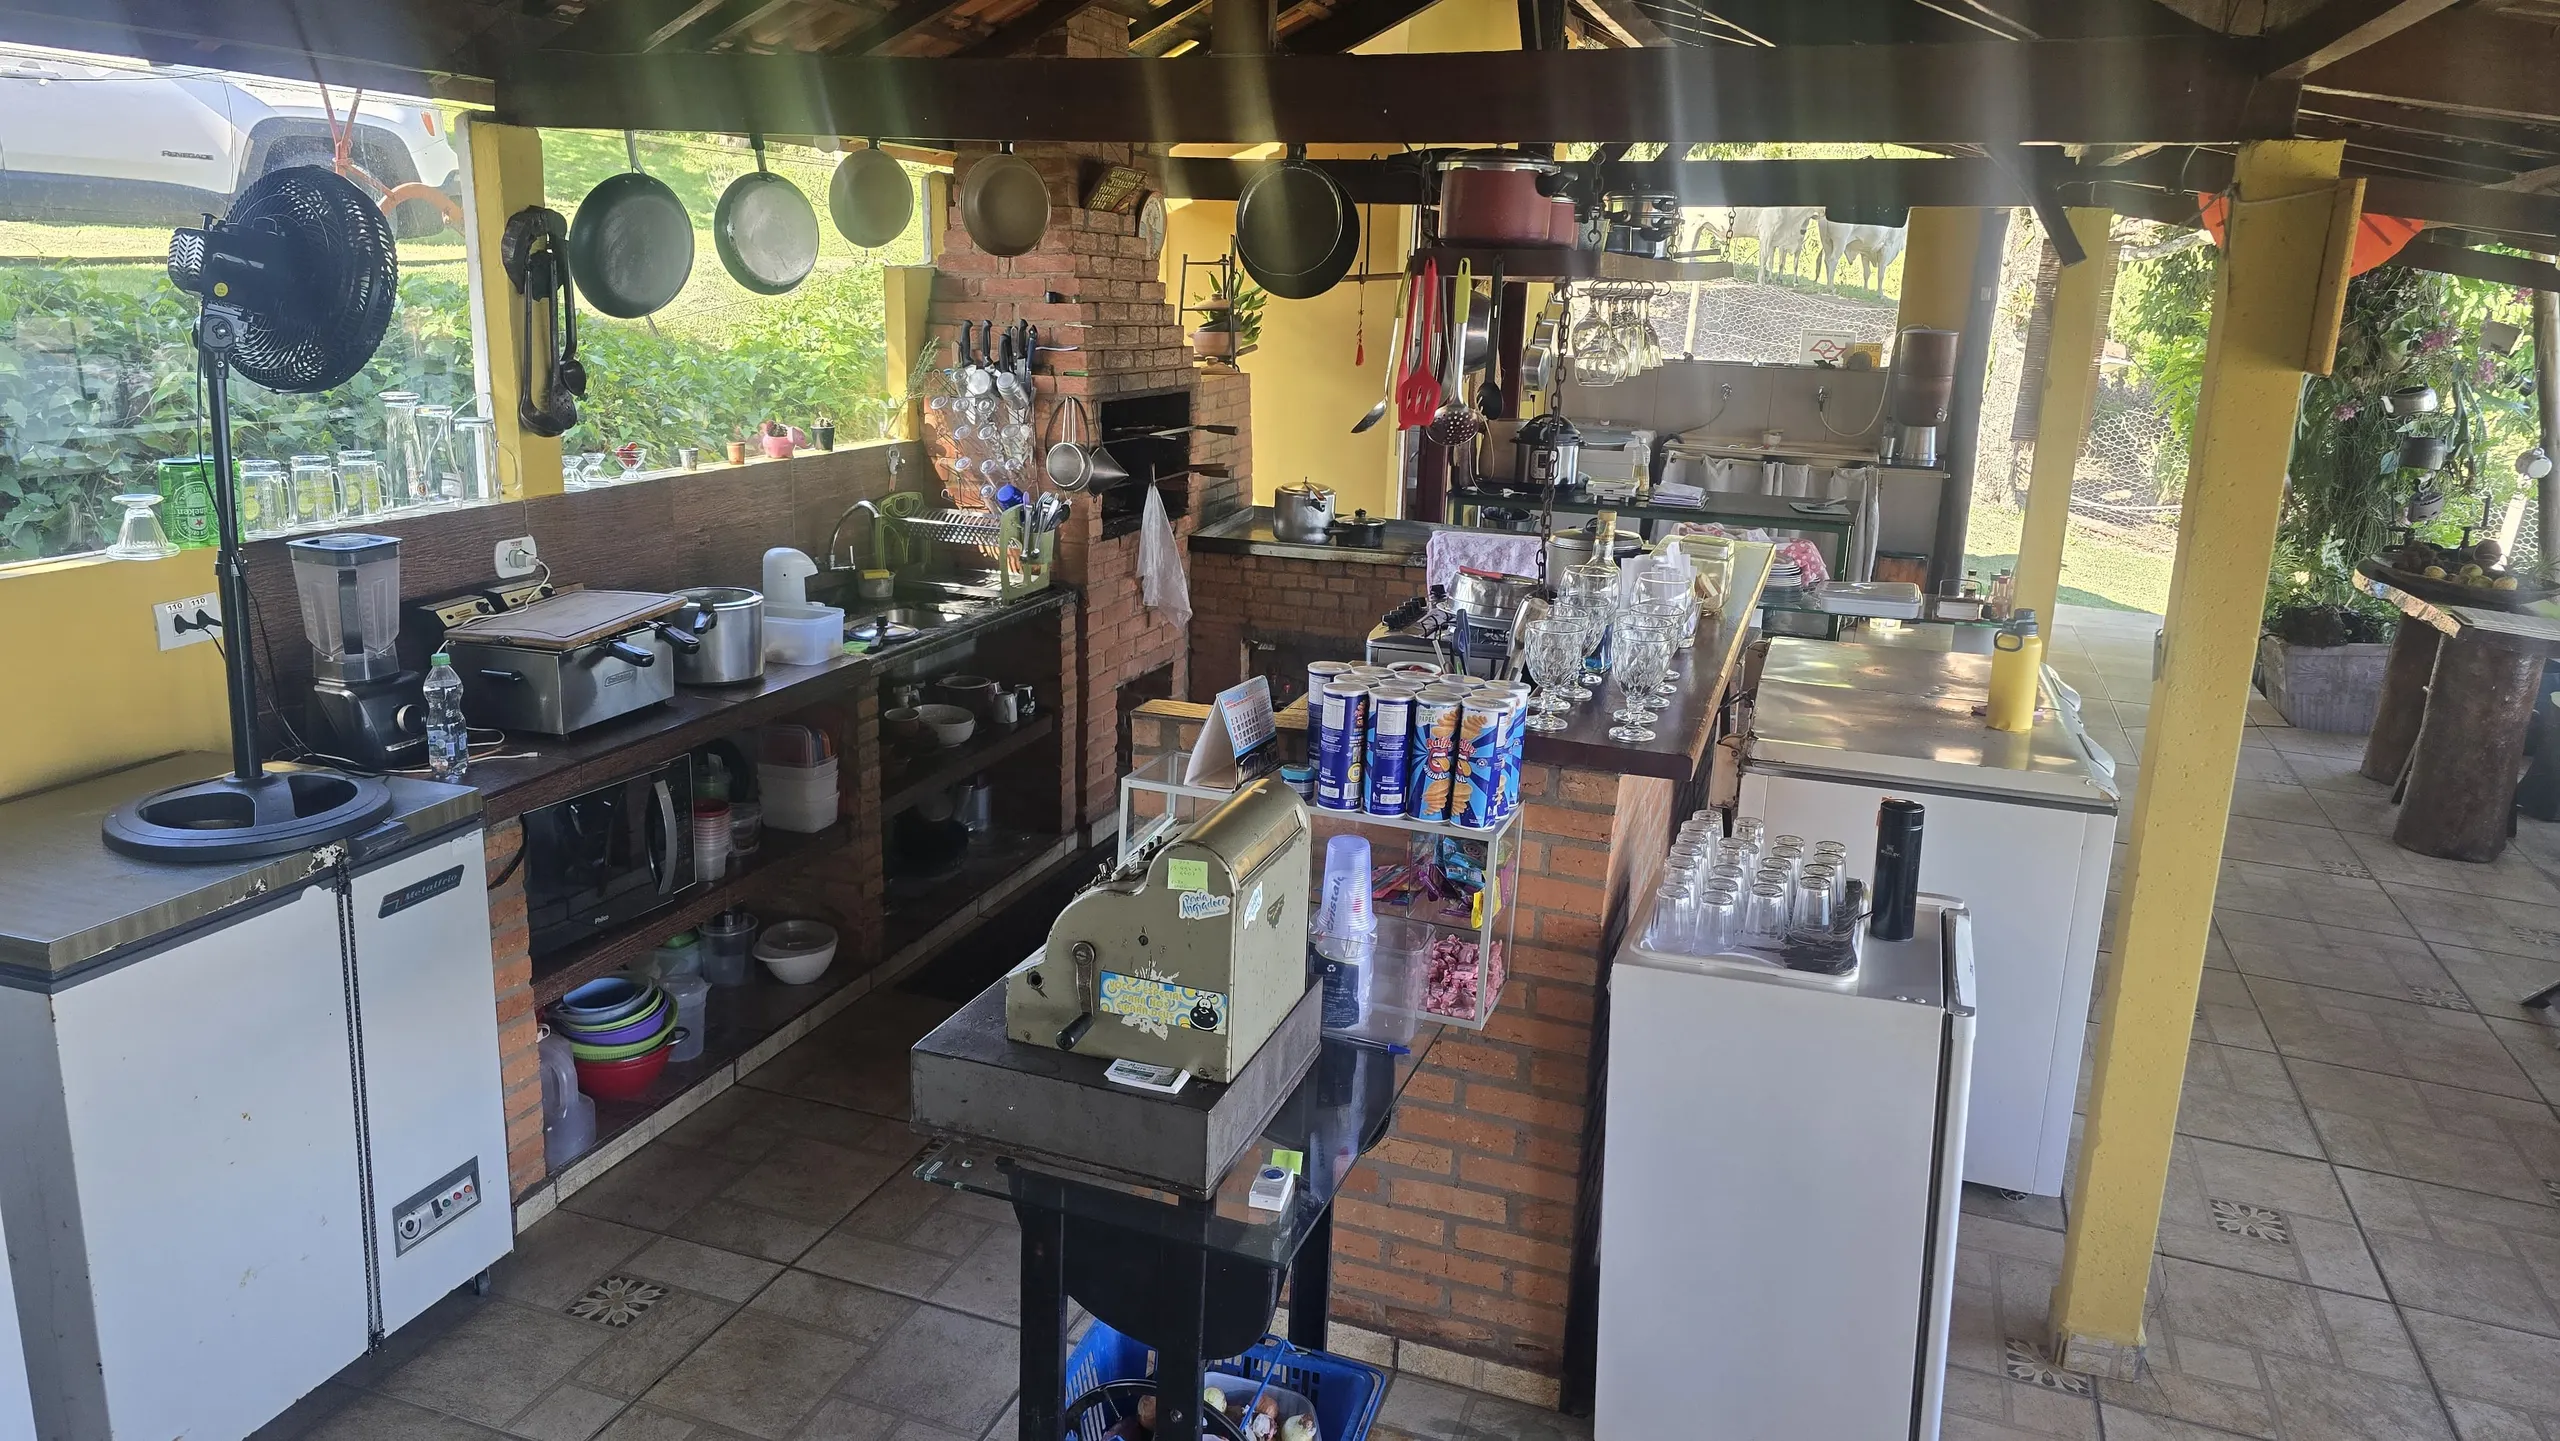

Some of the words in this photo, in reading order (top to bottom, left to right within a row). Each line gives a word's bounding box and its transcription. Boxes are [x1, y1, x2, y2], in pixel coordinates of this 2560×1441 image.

[161, 150, 214, 160] RENEGADE
[168, 603, 183, 611] 110
[191, 598, 206, 606] 110
[405, 874, 458, 901] Metalfrio
[1122, 993, 1147, 1004] PARA
[1124, 1004, 1149, 1015] PARA
[1152, 1010, 1175, 1021] DEUS
